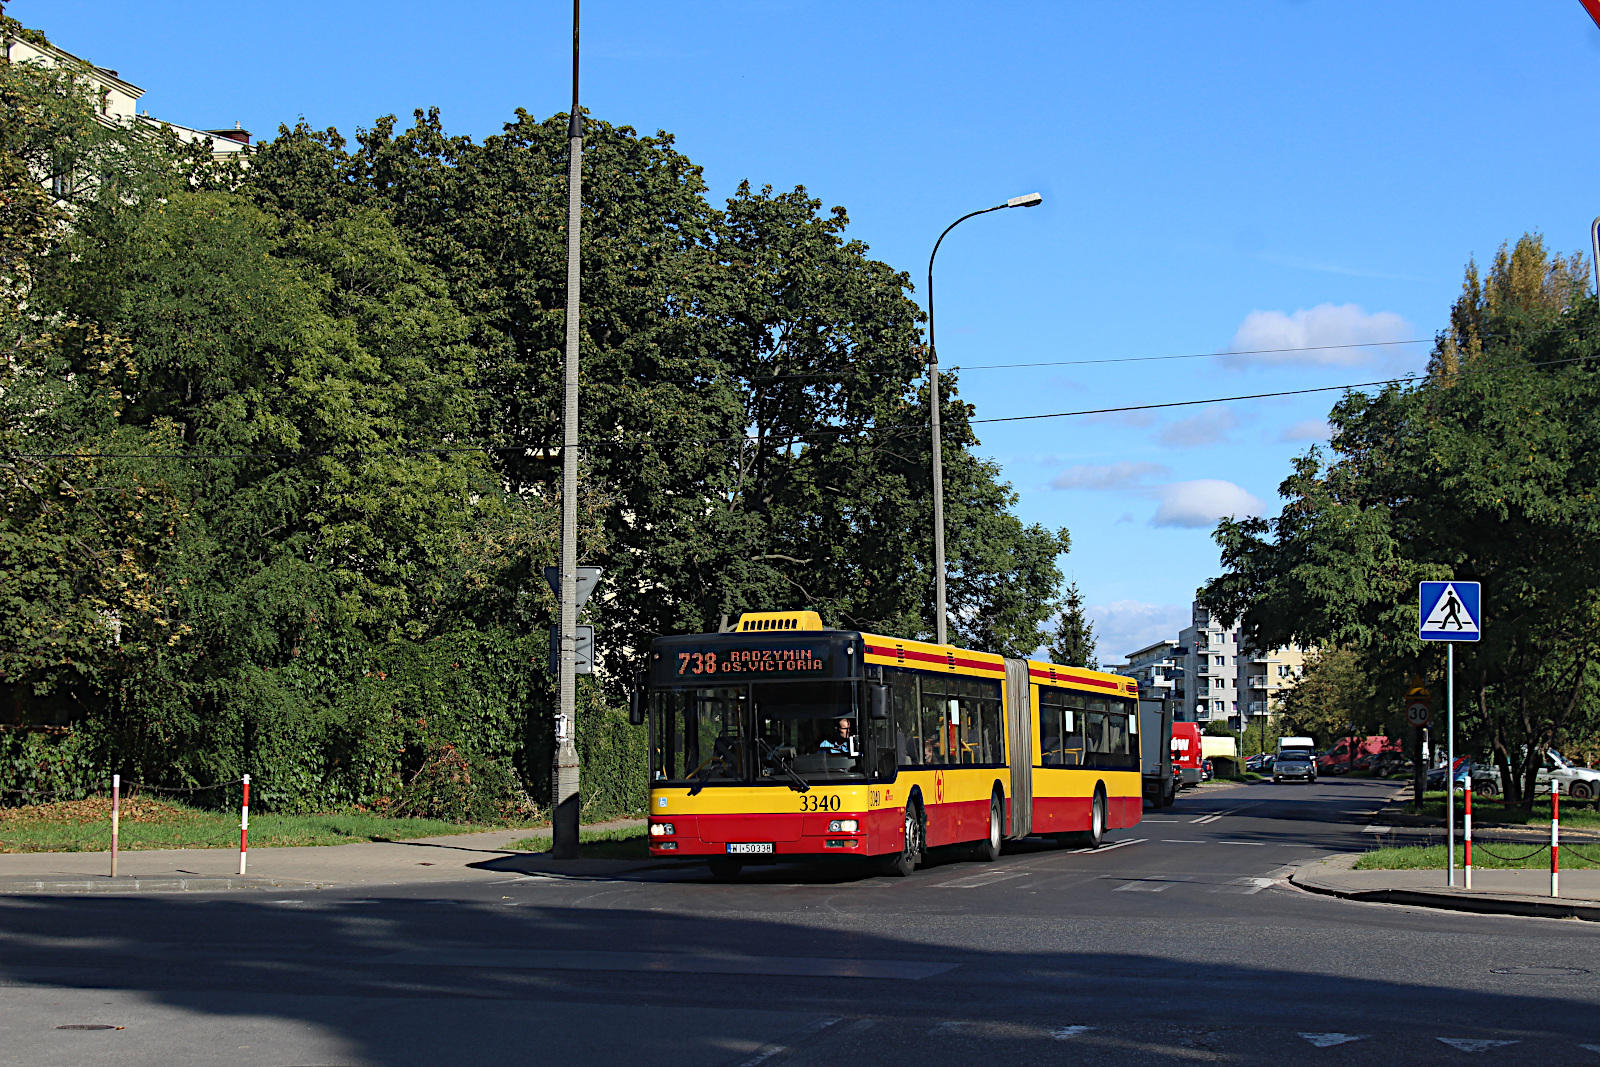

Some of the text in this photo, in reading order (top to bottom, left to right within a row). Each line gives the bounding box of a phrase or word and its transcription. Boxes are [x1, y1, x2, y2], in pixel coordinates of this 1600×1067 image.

[678, 652, 717, 674] 738
[730, 649, 812, 661] RADZYMIN
[1409, 707, 1427, 720] 30
[799, 795, 841, 812] 3340
[870, 790, 880, 806] 3340
